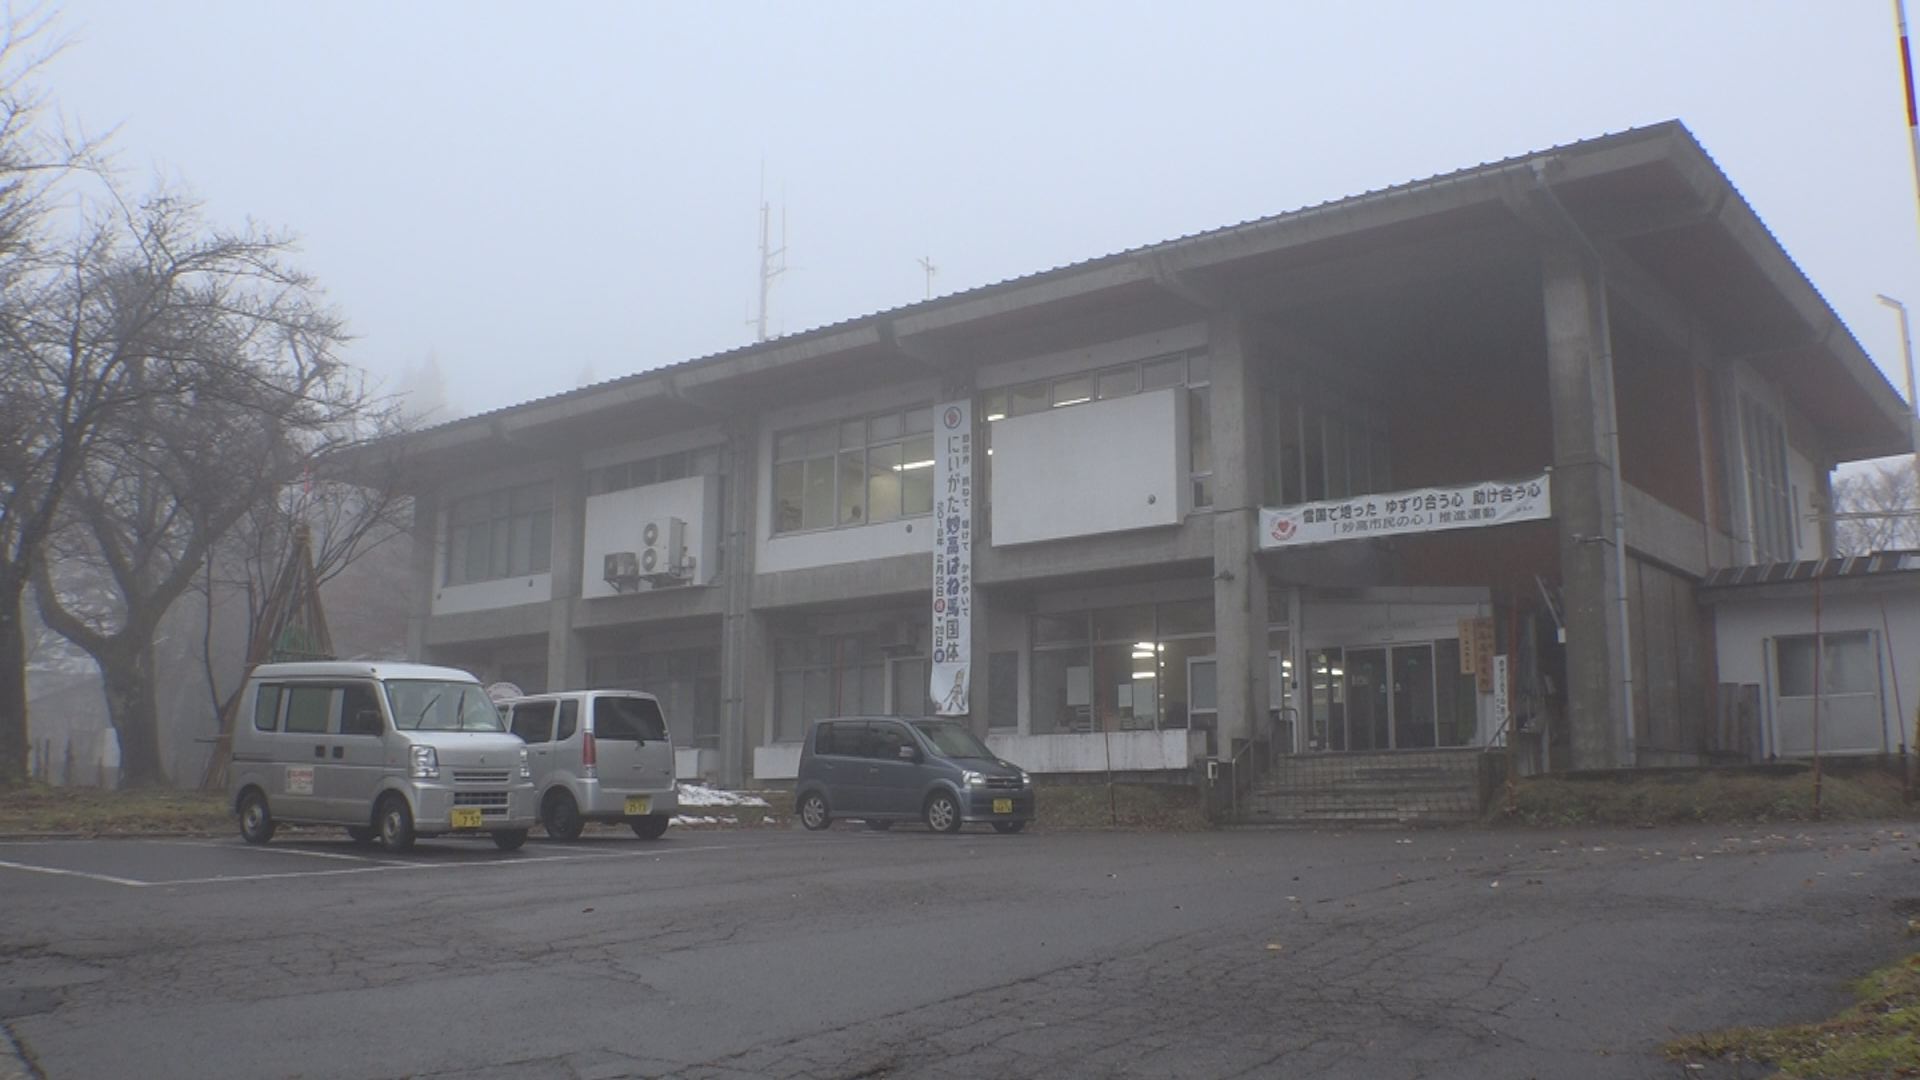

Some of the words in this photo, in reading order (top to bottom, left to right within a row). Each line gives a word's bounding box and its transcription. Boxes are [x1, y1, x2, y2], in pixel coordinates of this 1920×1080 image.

[1303, 502, 1377, 524] 雪国で培った
[1385, 492, 1464, 515] ゆずり合う心
[1473, 482, 1541, 505] 助け合う心
[946, 435, 961, 662] にいがた妙高はね馬国体
[960, 563, 970, 617] かがやいて
